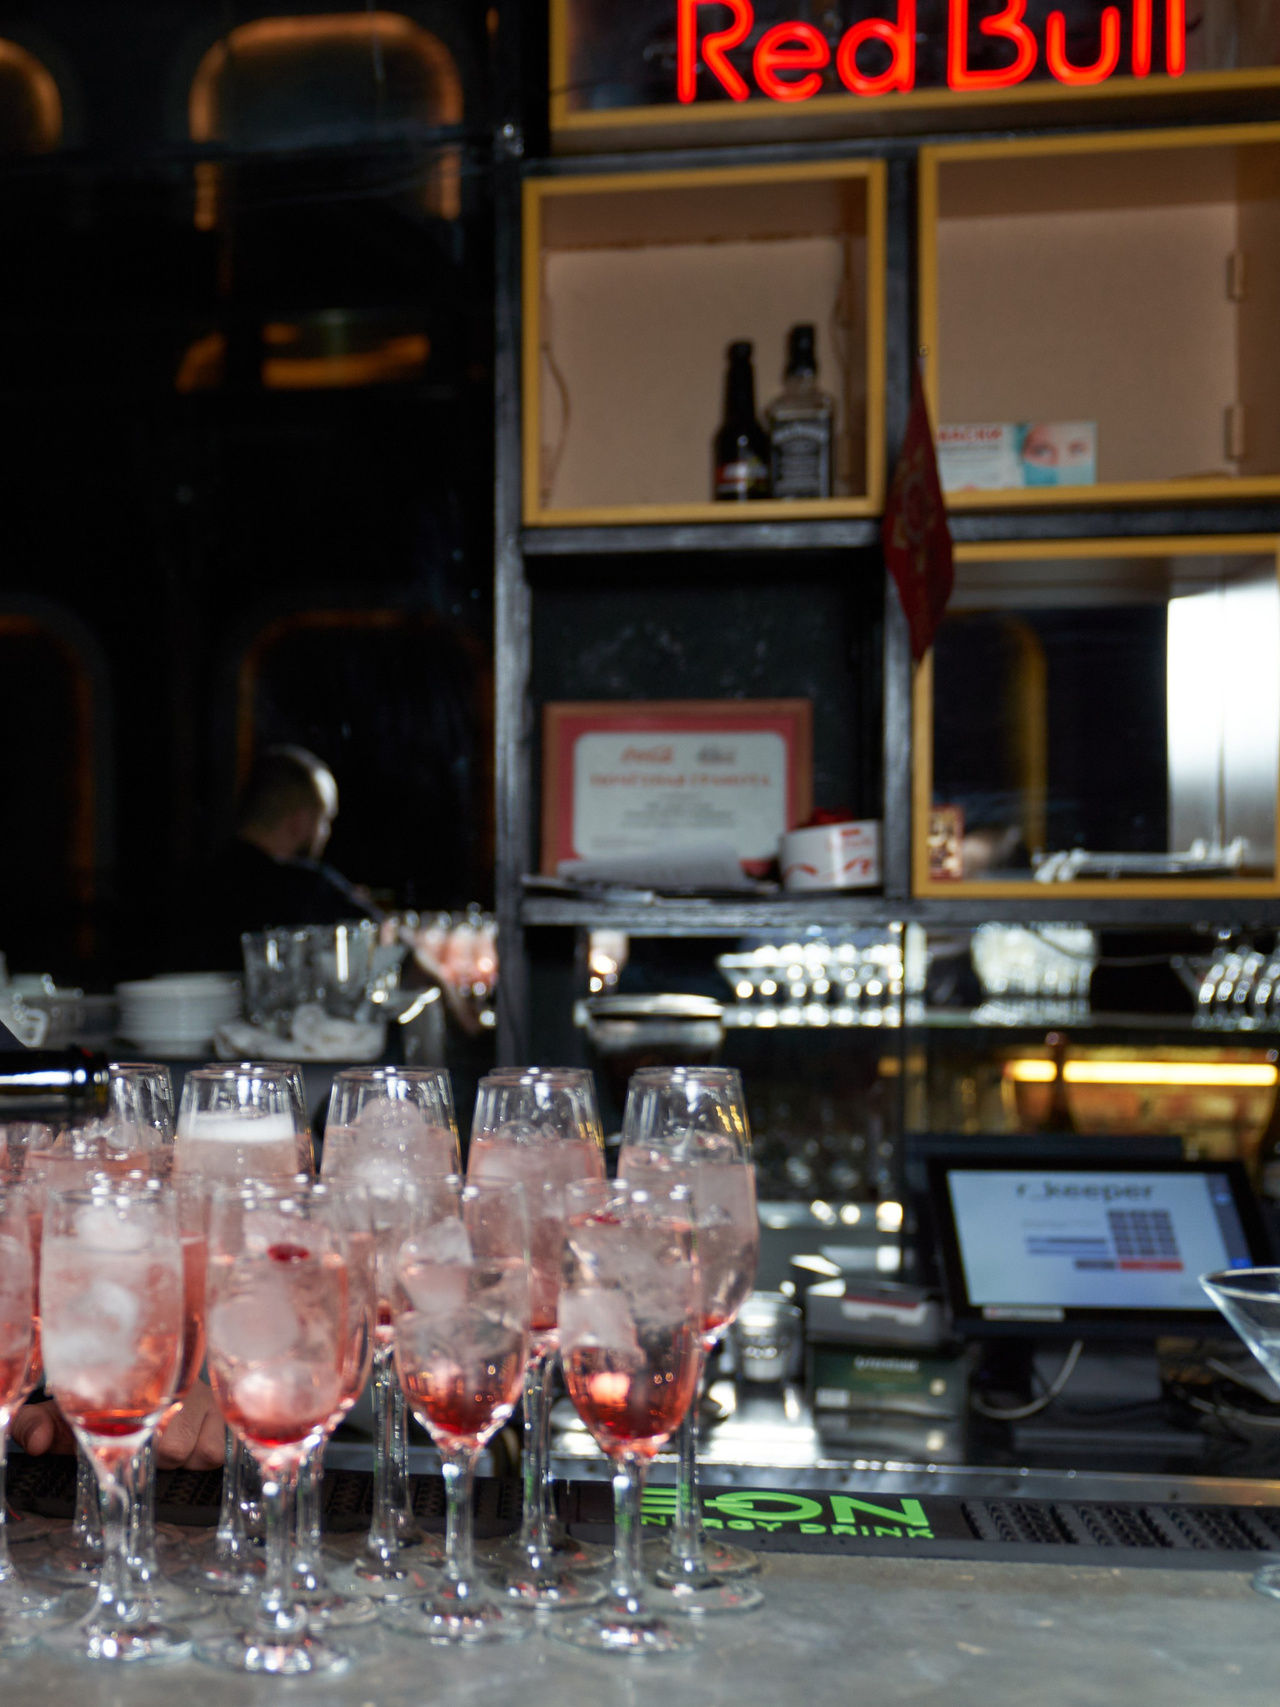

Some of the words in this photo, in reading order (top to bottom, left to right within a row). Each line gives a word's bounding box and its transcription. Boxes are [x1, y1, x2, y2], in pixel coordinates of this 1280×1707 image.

[676, 0, 917, 104] Red
[946, 0, 1187, 92] Bull
[1016, 1180, 1155, 1201] r_keeper
[636, 1514, 783, 1533] NRGY
[799, 1522, 935, 1540] DRINK
